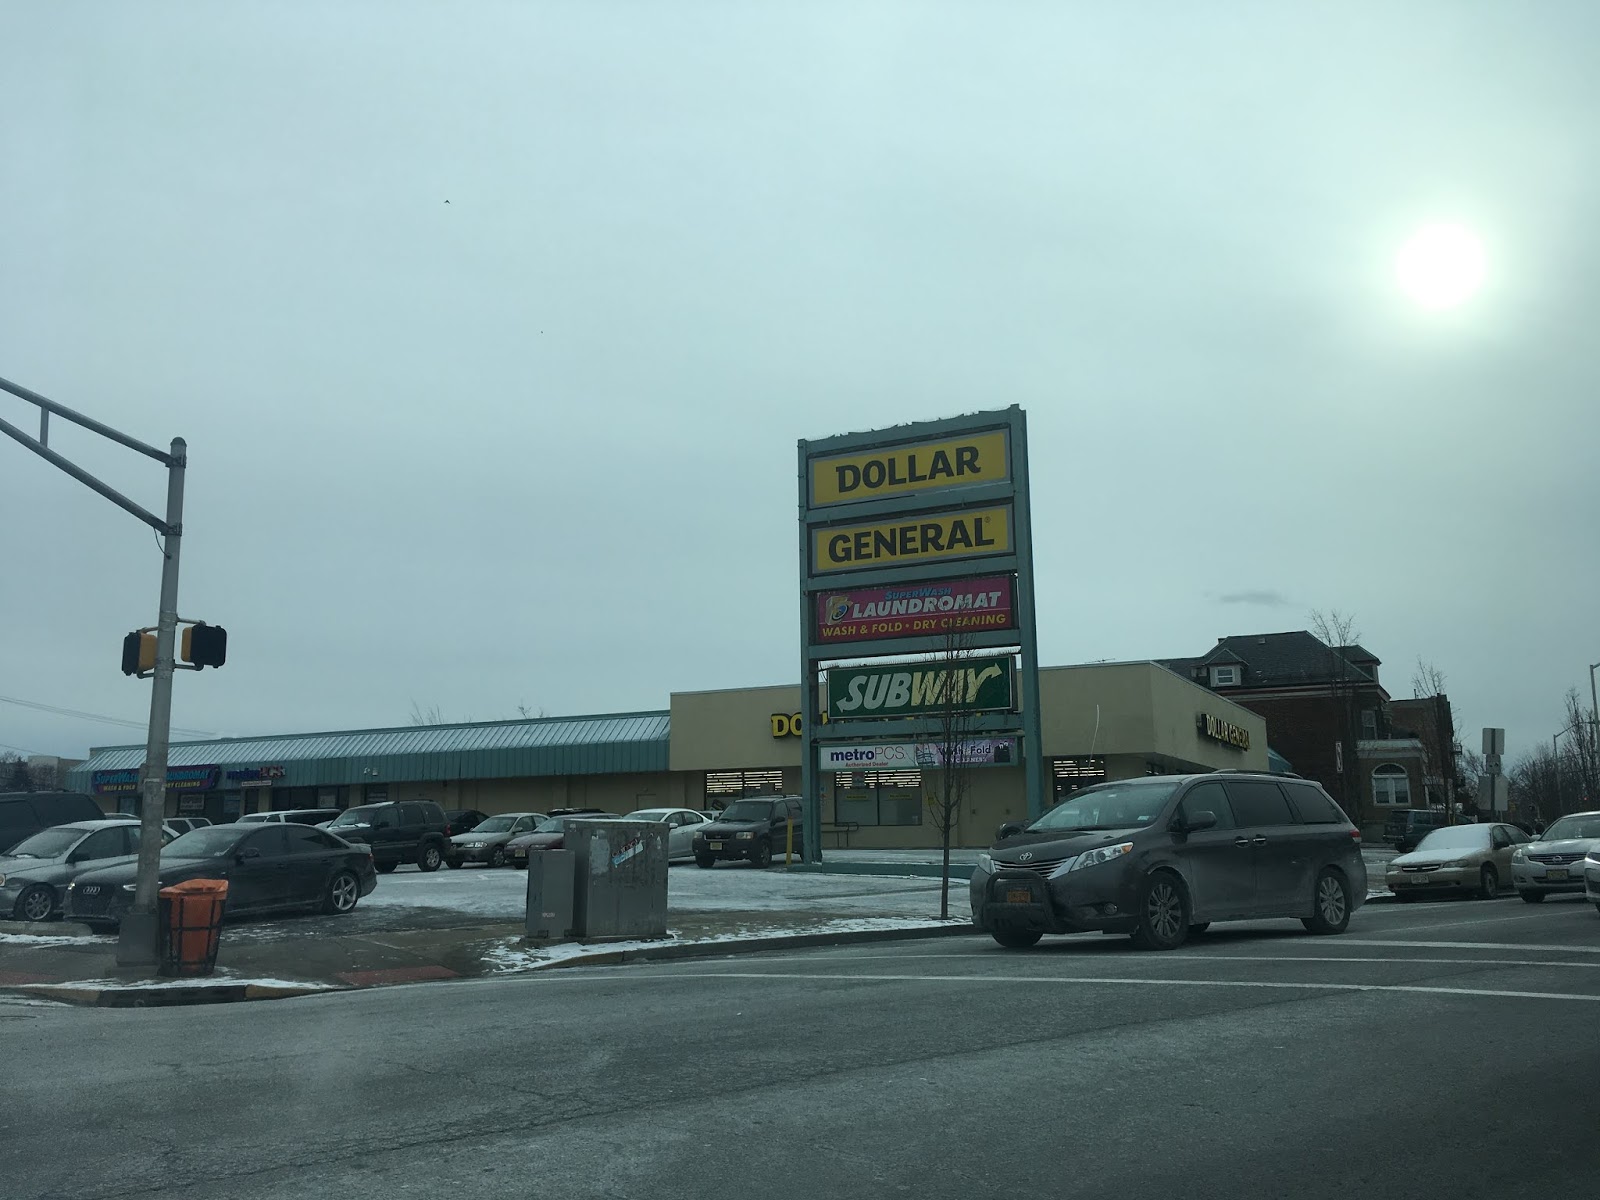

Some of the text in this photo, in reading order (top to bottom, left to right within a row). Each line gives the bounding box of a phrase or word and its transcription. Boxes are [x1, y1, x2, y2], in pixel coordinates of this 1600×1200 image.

[836, 446, 981, 493] DOLLAR
[828, 518, 994, 563] GENERAL
[852, 591, 1002, 619] LAUNDROMAT
[822, 613, 1007, 637] WASH & FOLD DRY CLEANING
[836, 663, 1003, 713] SUBWAY
[830, 746, 905, 762] metroPCS
[970, 744, 991, 755] Fold
